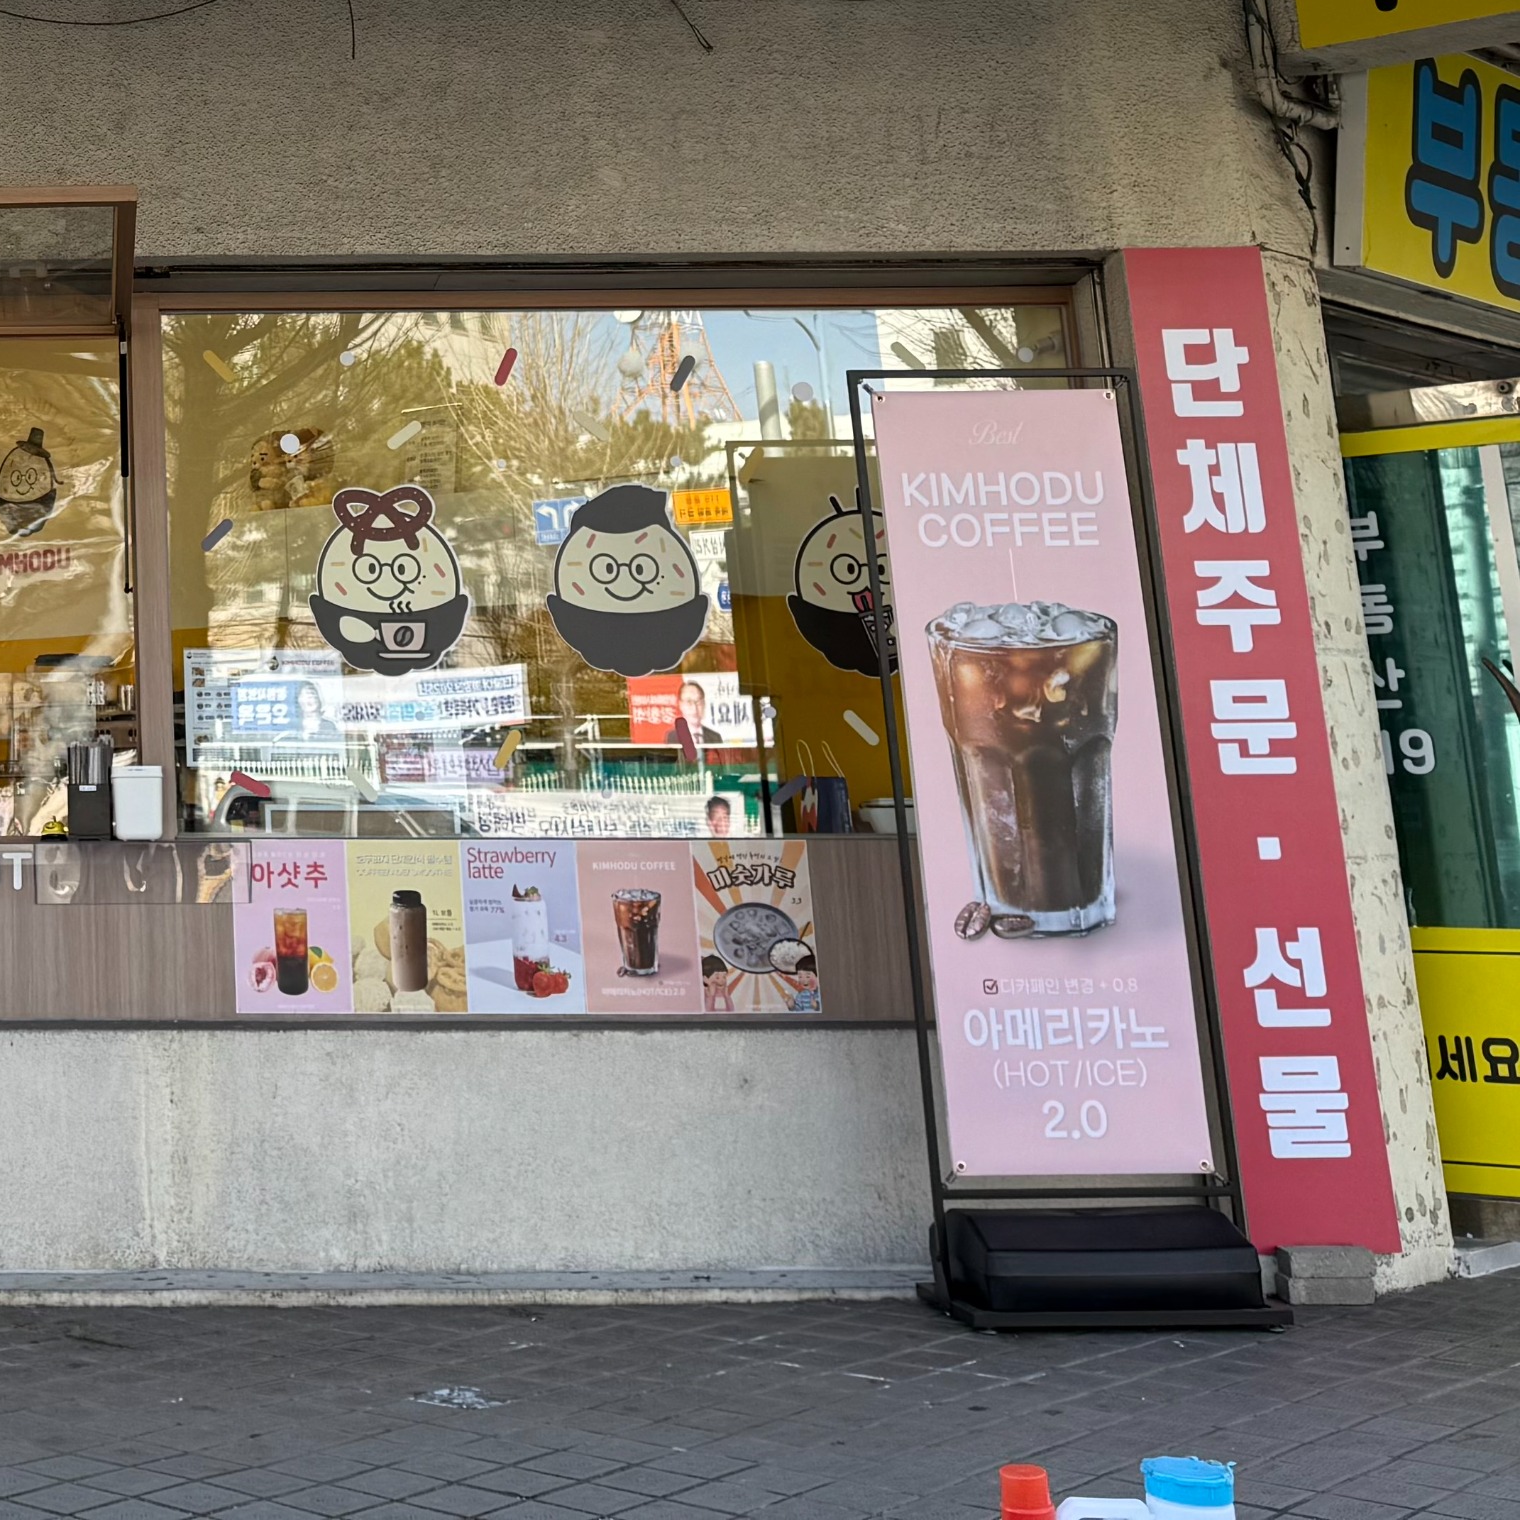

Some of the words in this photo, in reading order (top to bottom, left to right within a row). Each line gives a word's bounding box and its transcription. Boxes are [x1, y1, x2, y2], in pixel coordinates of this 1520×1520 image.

[968, 420, 1023, 446] Best
[901, 471, 1104, 507] KIMHODU
[917, 511, 1100, 548] COFFEE
[467, 846, 557, 868] Strawberry
[468, 860, 505, 879] latte
[592, 861, 638, 871] KIMHODU
[640, 861, 677, 871] COFFEE
[252, 861, 328, 889] 아샷추
[707, 862, 797, 892] 미숫가루
[963, 1006, 1169, 1051] 아메리카노
[993, 1059, 1148, 1089] (HOT/ICE)
[1042, 1100, 1108, 1140] 2.0
